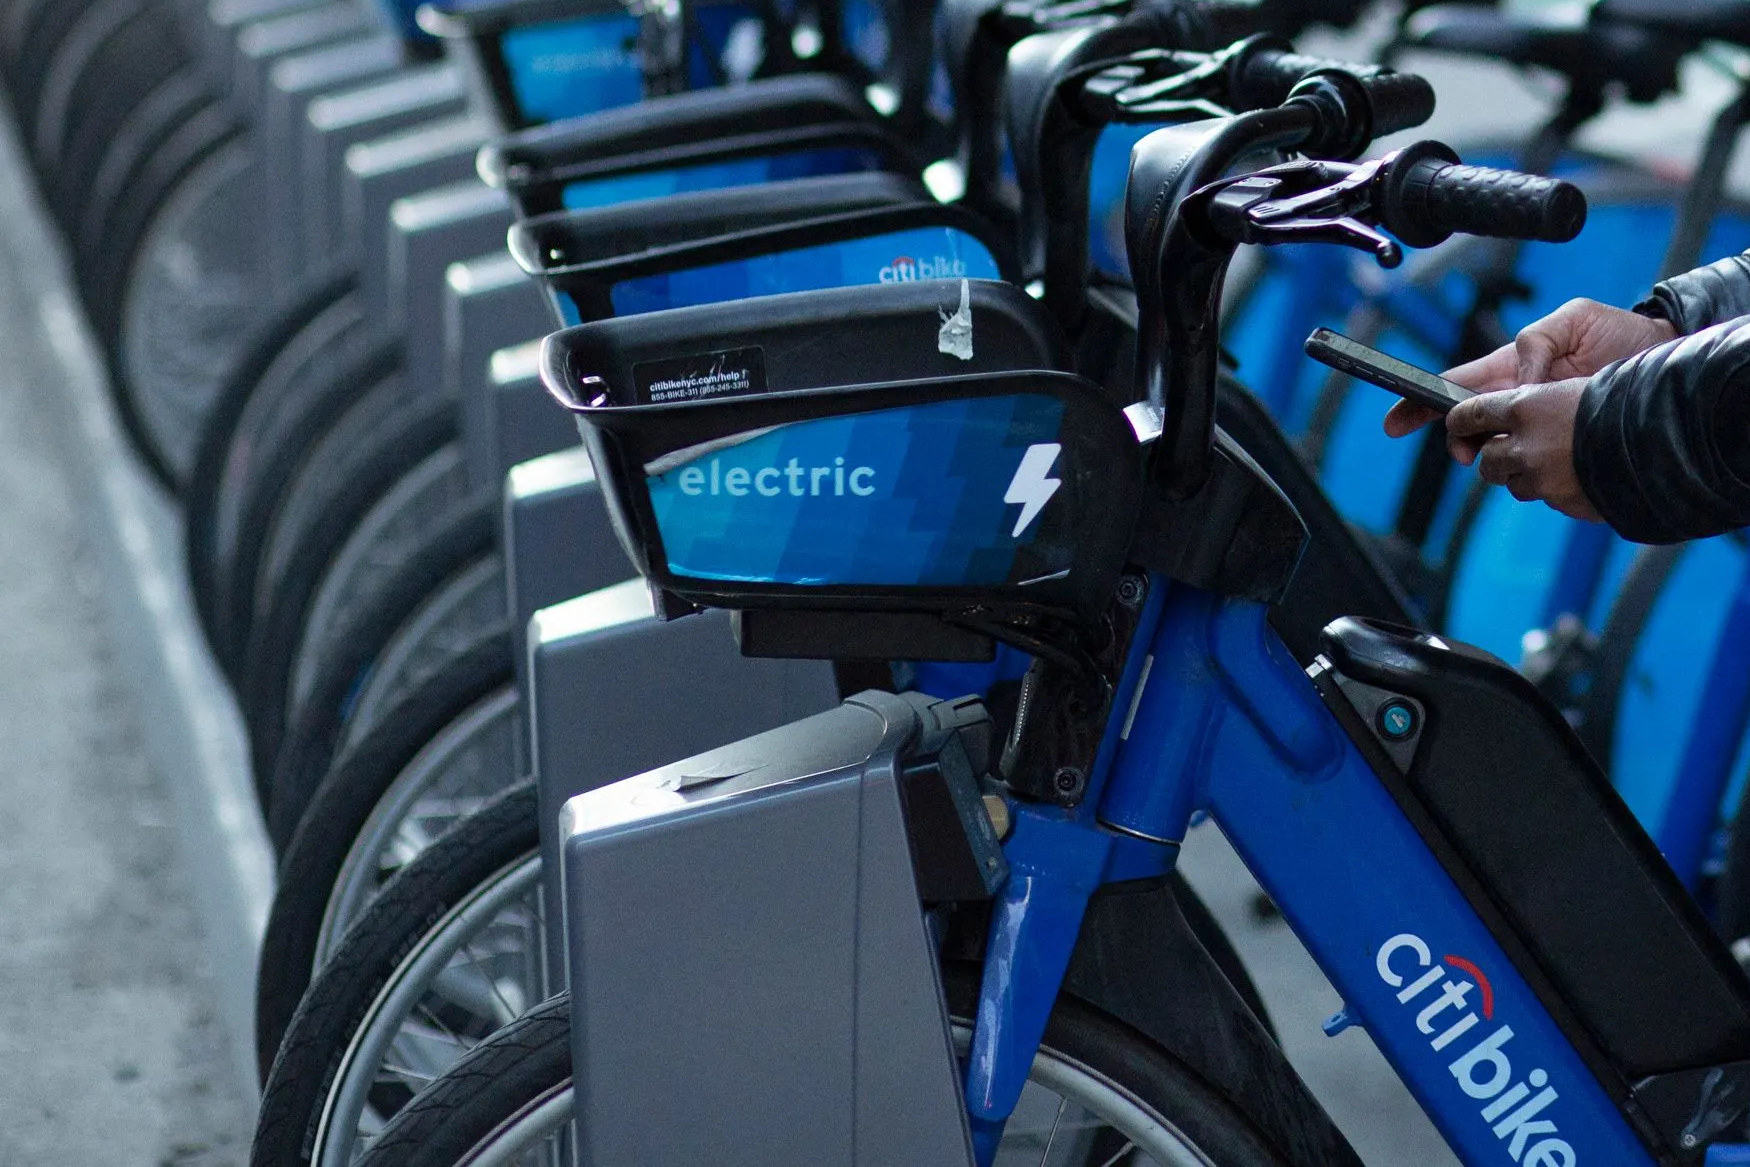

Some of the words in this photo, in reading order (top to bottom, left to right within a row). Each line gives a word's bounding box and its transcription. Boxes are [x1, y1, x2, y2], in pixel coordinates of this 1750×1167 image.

[879, 255, 915, 285] citi
[649, 371, 740, 392] citibikenyc.com/help
[678, 456, 876, 496] electric
[1376, 933, 1494, 1053] citi
